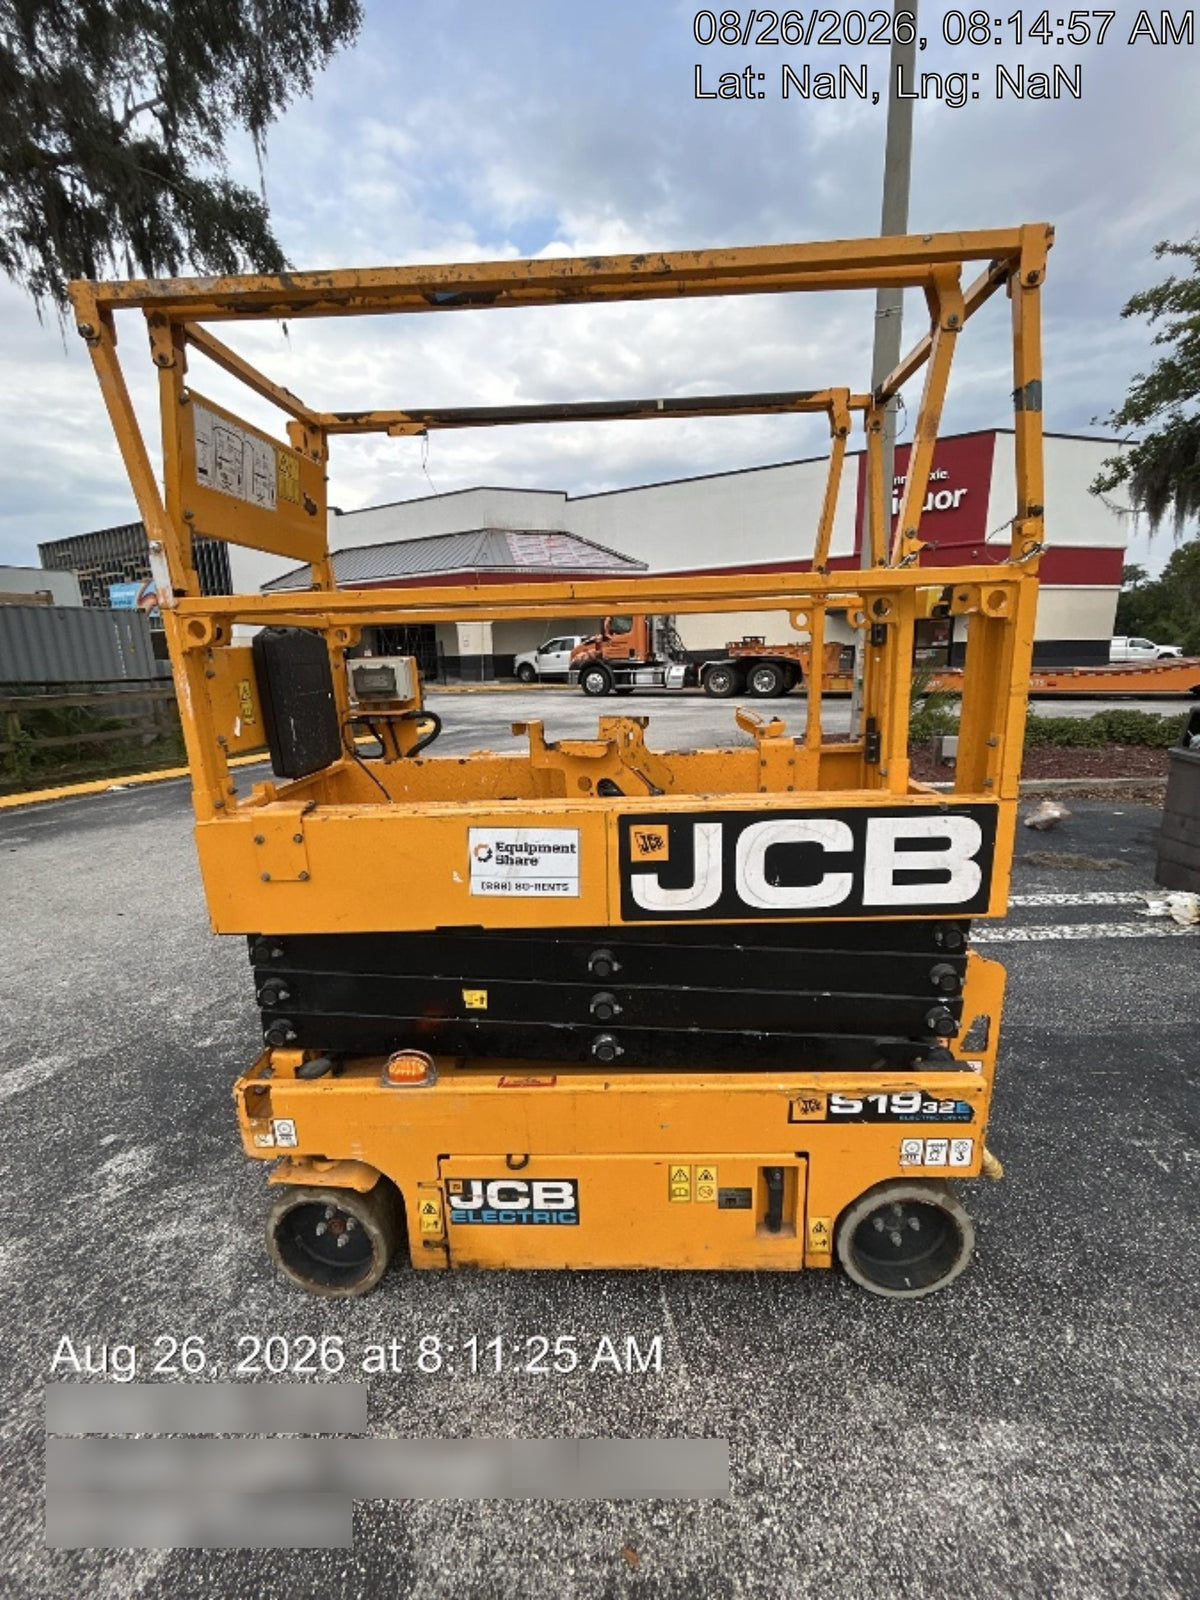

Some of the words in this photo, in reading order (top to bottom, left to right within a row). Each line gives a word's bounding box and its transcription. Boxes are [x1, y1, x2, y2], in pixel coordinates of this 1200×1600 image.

[495, 842, 576, 855] Equipment
[495, 855, 539, 866] Share
[630, 815, 983, 911] JCB
[449, 1180, 576, 1210] JCB
[451, 1210, 577, 1224] ELECTRIC
